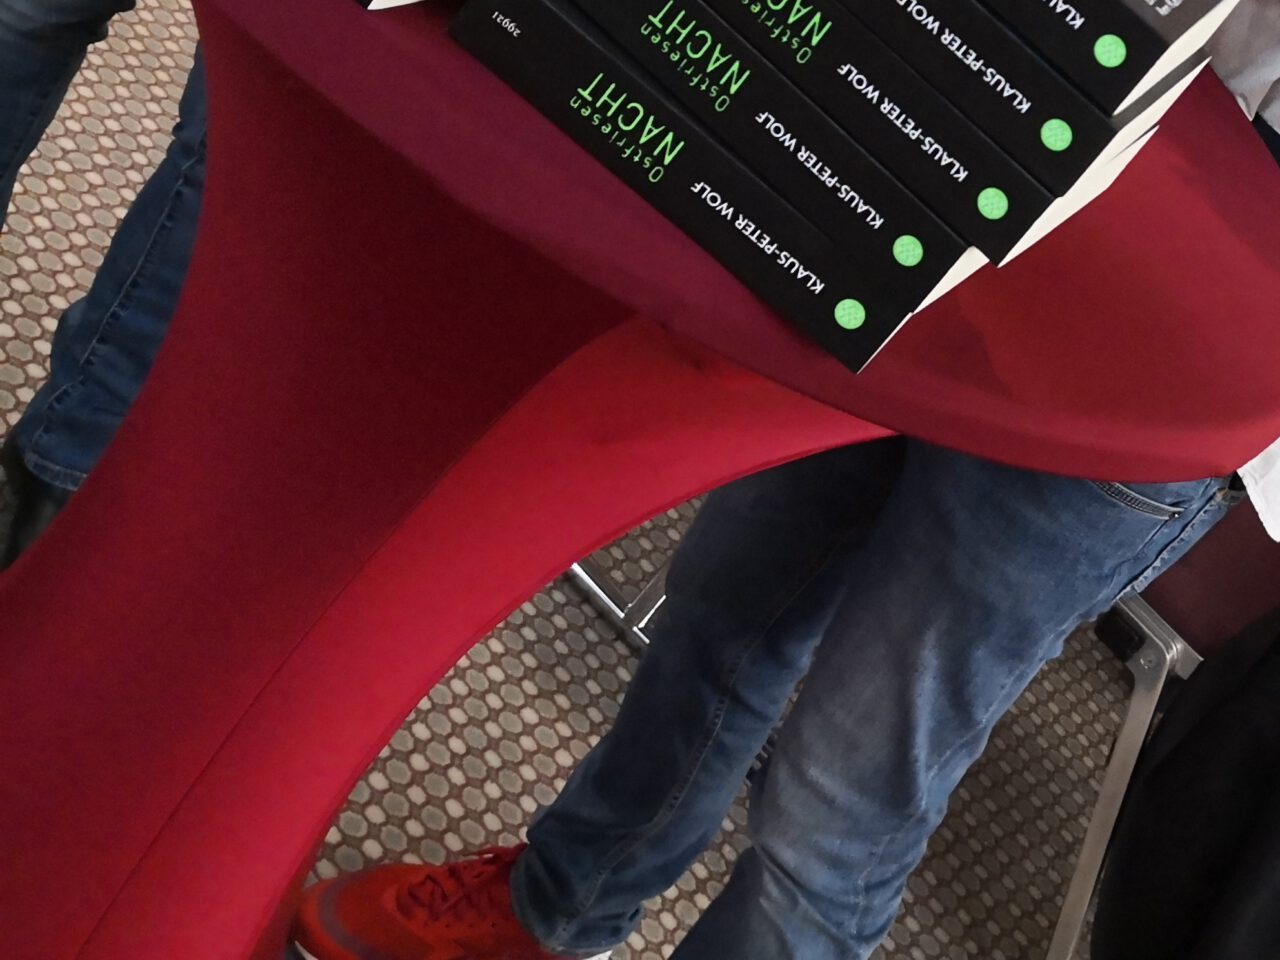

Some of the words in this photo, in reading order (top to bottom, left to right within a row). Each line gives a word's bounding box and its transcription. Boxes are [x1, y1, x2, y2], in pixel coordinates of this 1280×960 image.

[641, 26, 730, 112] Ostfriesen
[648, 0, 751, 94] NACHT
[836, 63, 880, 104] WOLF
[940, 28, 1032, 114] KLAUS-PETER
[570, 97, 664, 182] Ostfriesen
[577, 73, 685, 166] NACHT
[754, 111, 797, 152] WOLF
[879, 97, 969, 183] KLAUS-PETER
[690, 181, 735, 221] WOLF
[796, 145, 885, 230] KLAUS-PETER
[734, 213, 825, 295] KLAUS-PETER
